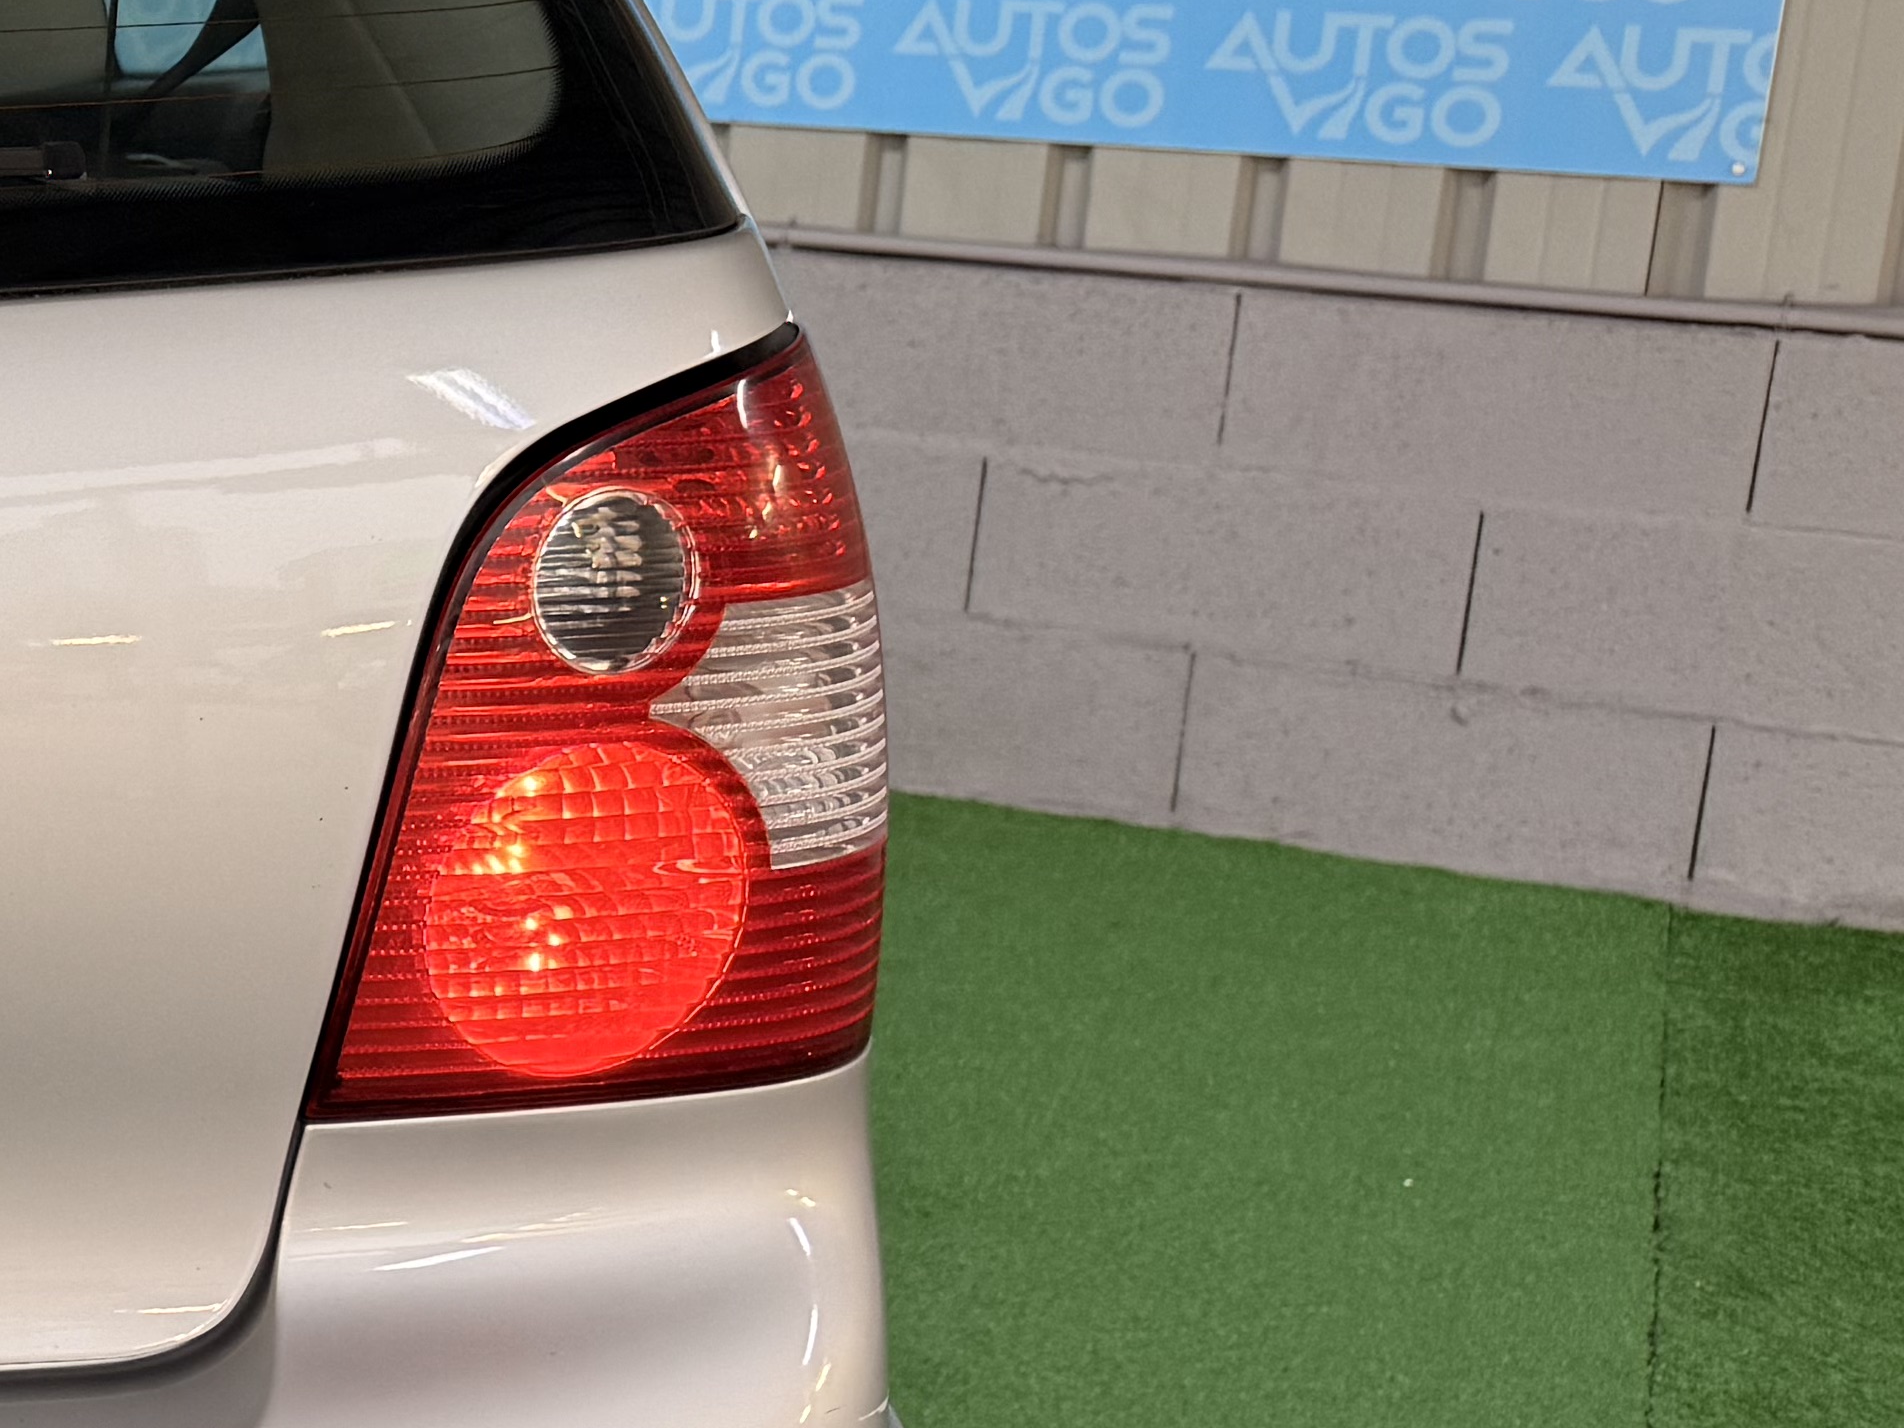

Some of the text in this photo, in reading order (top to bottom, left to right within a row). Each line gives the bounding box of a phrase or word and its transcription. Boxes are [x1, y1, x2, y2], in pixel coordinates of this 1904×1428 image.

[1205, 8, 1513, 83] AUTOS
[949, 54, 1163, 128] VIGO
[1266, 72, 1501, 148] VIGO
